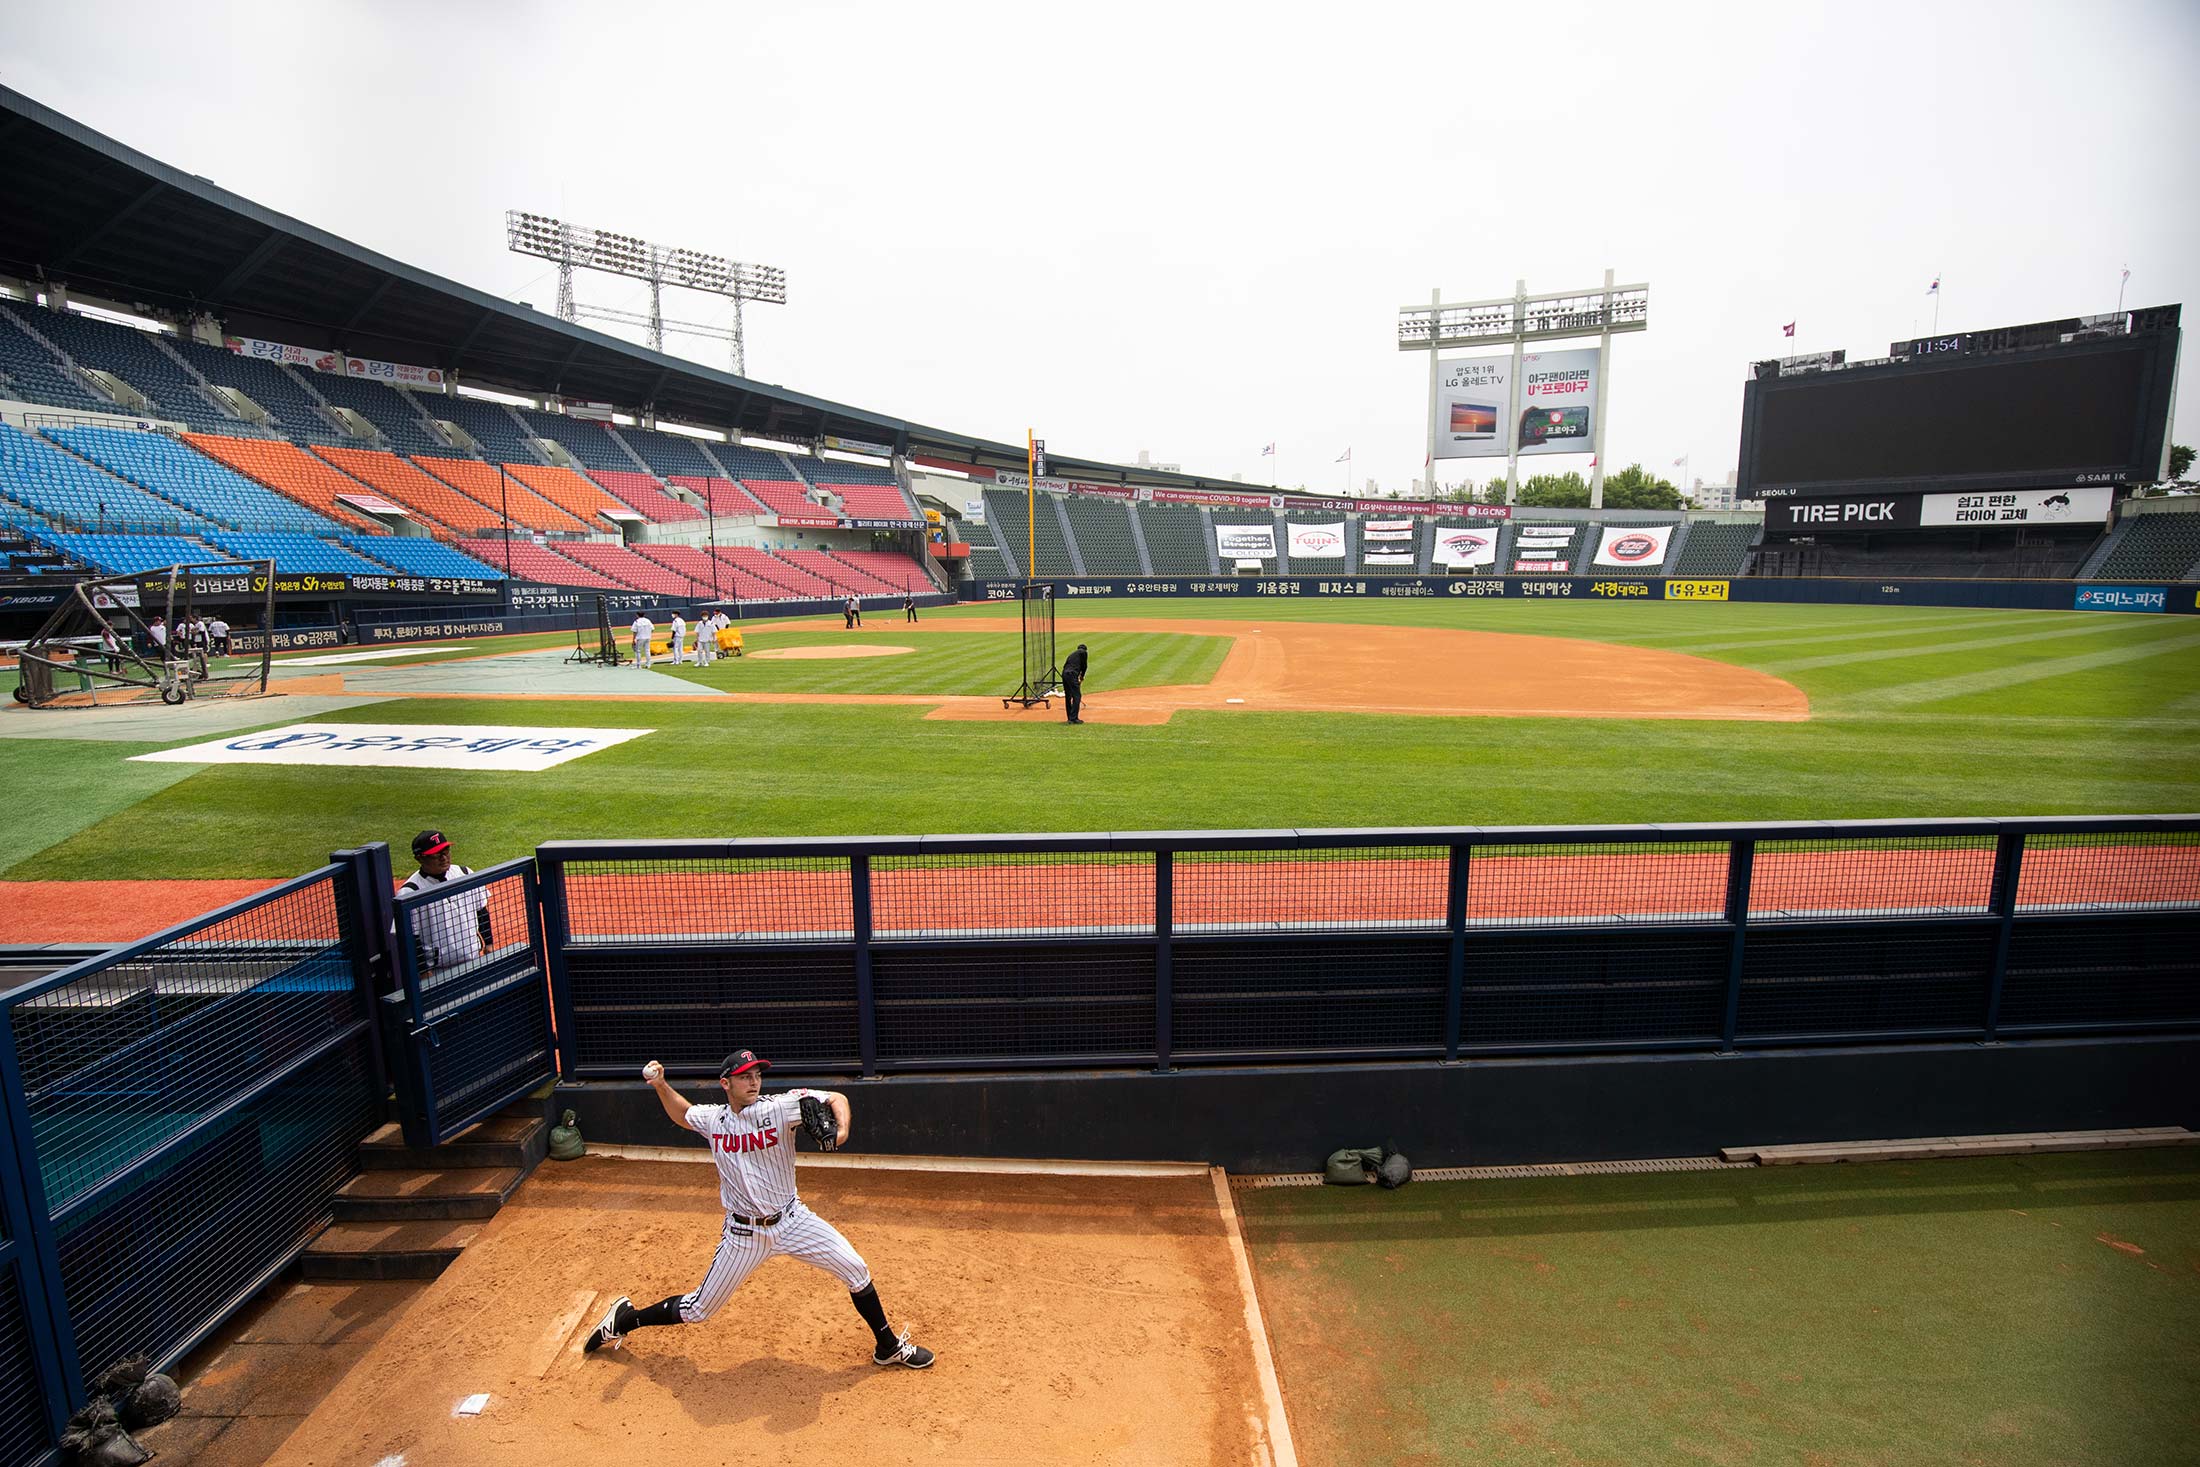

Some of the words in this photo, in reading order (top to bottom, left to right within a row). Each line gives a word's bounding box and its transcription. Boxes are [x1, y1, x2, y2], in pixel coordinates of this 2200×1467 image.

[252, 340, 283, 361] 문경
[1916, 338, 1959, 355] 11:54
[368, 361, 394, 378] 문경
[1455, 366, 1480, 377] 압도적
[1482, 364, 1495, 375] 1위
[1528, 369, 1590, 384] 야구팬이라면
[1445, 378, 1458, 388] LG
[1462, 376, 1488, 388] 올레드
[1490, 375, 1504, 385] TV
[1528, 381, 1589, 397] U+프로야구
[2087, 473, 2111, 482] SAM
[1155, 491, 1165, 499] We
[1178, 494, 1208, 502] overcome
[1209, 495, 1241, 503] COVID-19
[1241, 496, 1269, 506] together
[1322, 501, 1333, 509] LG
[1957, 496, 1984, 508] 쉽고
[1988, 494, 2017, 507] 편한
[1478, 507, 1489, 516] LG
[1490, 508, 1507, 516] CNS
[1789, 504, 1840, 523] TIRE
[1844, 502, 1896, 521] PICK
[1956, 509, 1996, 521] 타이어
[2000, 508, 2028, 520] 교체
[1293, 536, 1340, 545] TWINS
[1447, 542, 1480, 552] TWIN
[193, 577, 250, 594] 신협보험
[302, 576, 319, 591] Sh
[320, 581, 346, 590] 수협보험
[353, 577, 389, 591] 태성자동문
[1137, 583, 1177, 593] 유안타증권
[1257, 582, 1300, 595] 키움증권
[1319, 582, 1366, 594] 피자스쿨
[1467, 581, 1504, 596] 금강주택
[1521, 581, 1573, 596] 현대해상
[1591, 582, 1649, 597] 서경대학교
[1682, 583, 1725, 598] 유보라
[1382, 587, 1434, 596] 해링턴플레이스
[511, 595, 580, 609] 한국경제신문
[606, 595, 660, 608] 국경제TV
[2090, 591, 2165, 607] 도미노피자
[308, 631, 338, 646] 금강주택
[374, 628, 396, 640] 투자,
[396, 626, 422, 638] 문화가
[424, 625, 440, 636] 되다
[740, 1051, 753, 1062] T
[756, 1117, 772, 1129] LG
[712, 1127, 778, 1153] TWINS
